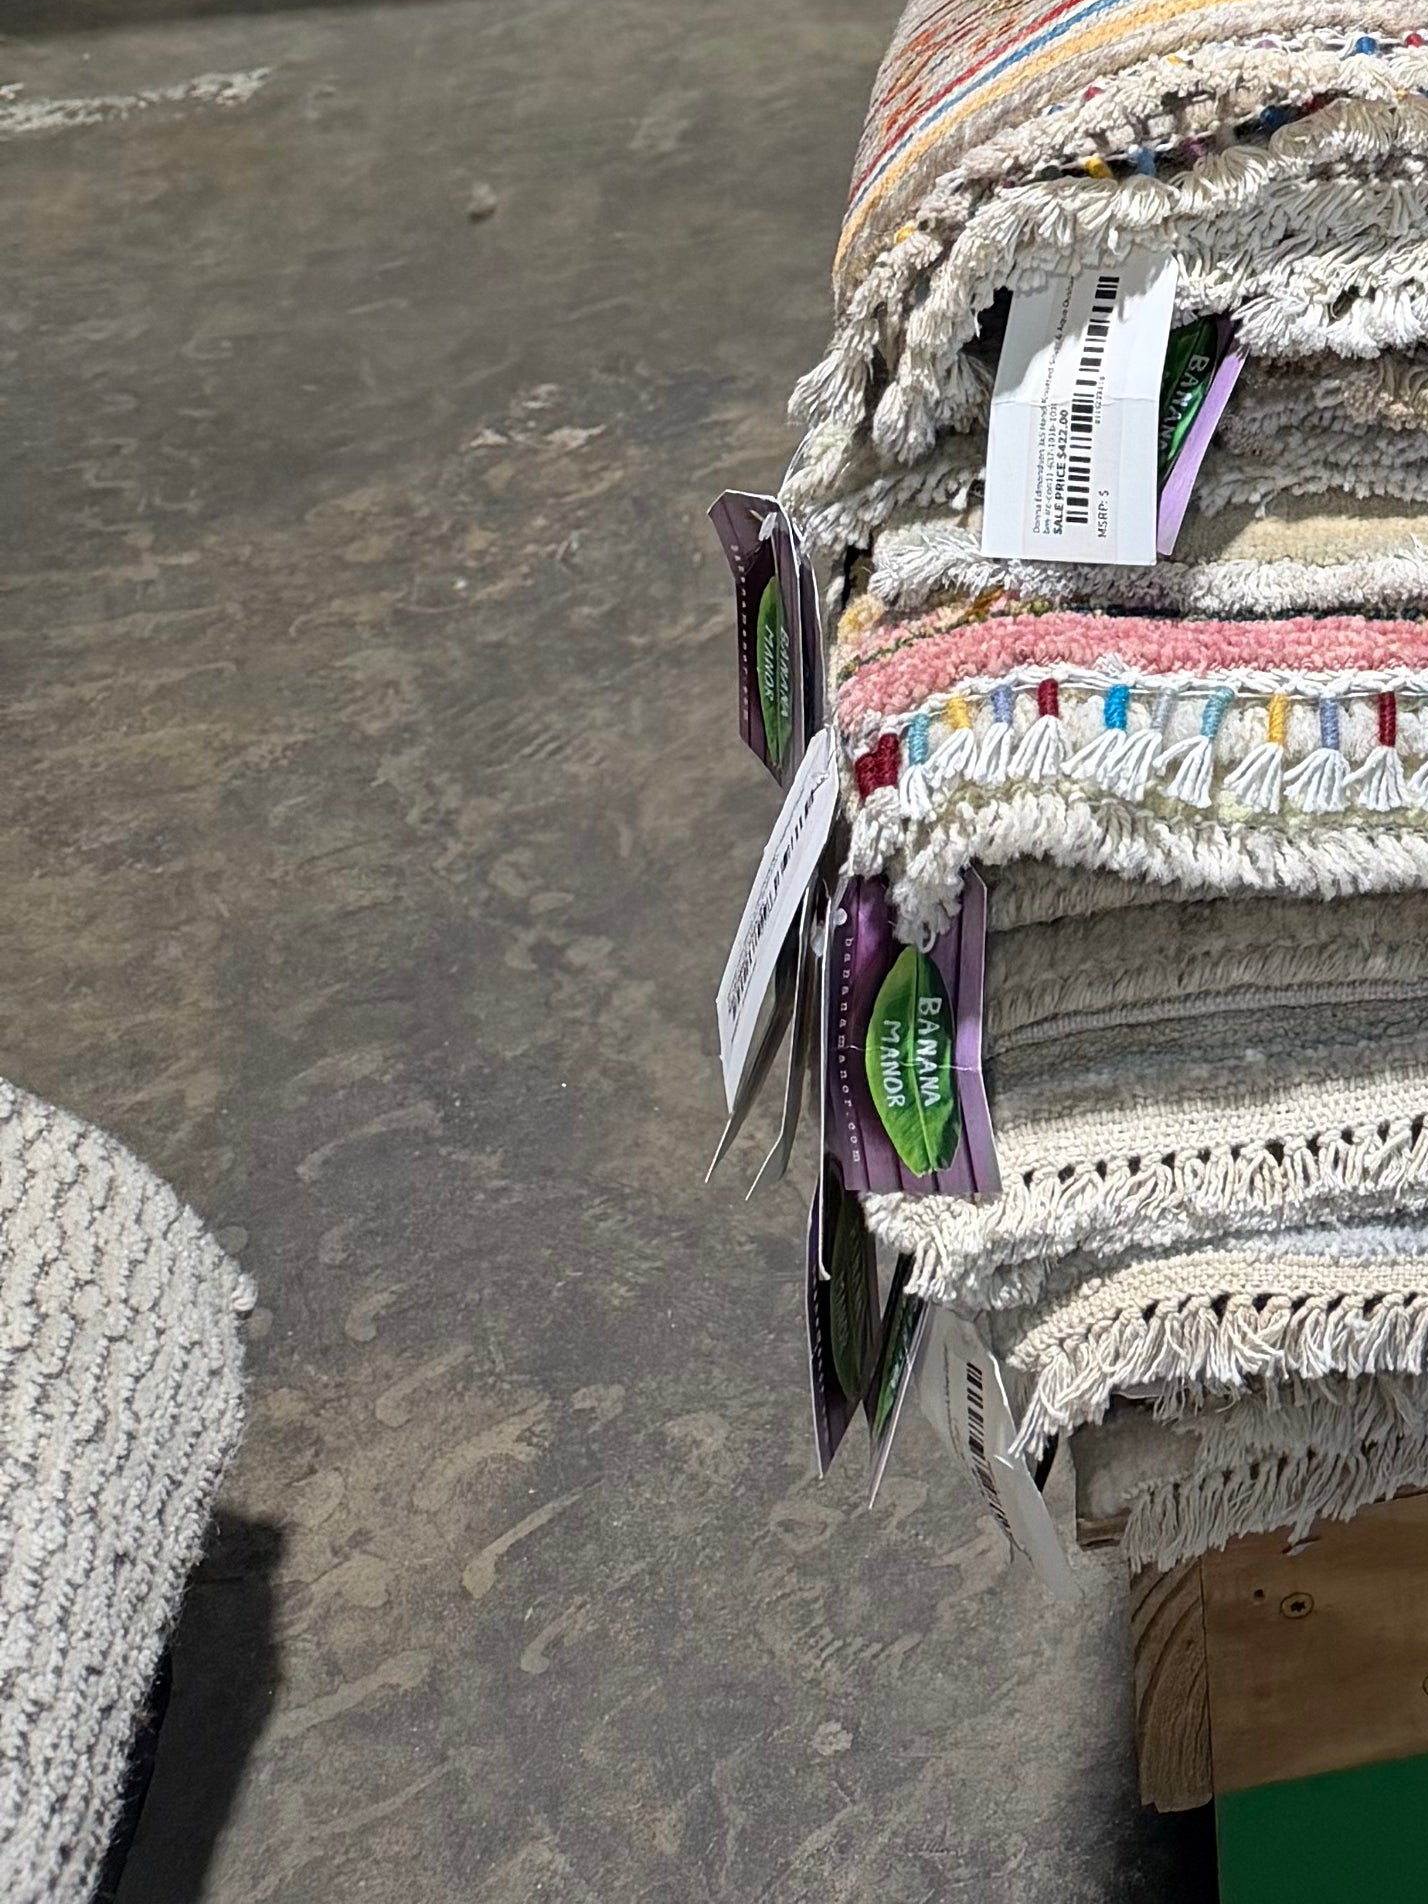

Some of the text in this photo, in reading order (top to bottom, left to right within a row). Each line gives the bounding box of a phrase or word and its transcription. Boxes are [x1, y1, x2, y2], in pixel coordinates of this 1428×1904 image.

[1051, 409, 1069, 535] SALE PRICE $422.00
[1096, 499, 1109, 537] MSRP:
[763, 623, 774, 701] MANOR
[778, 625, 790, 717] BANANA
[836, 936, 862, 1162] bananamanor.com
[879, 1019, 906, 1107] MANOR
[916, 995, 942, 1107] BANANA
